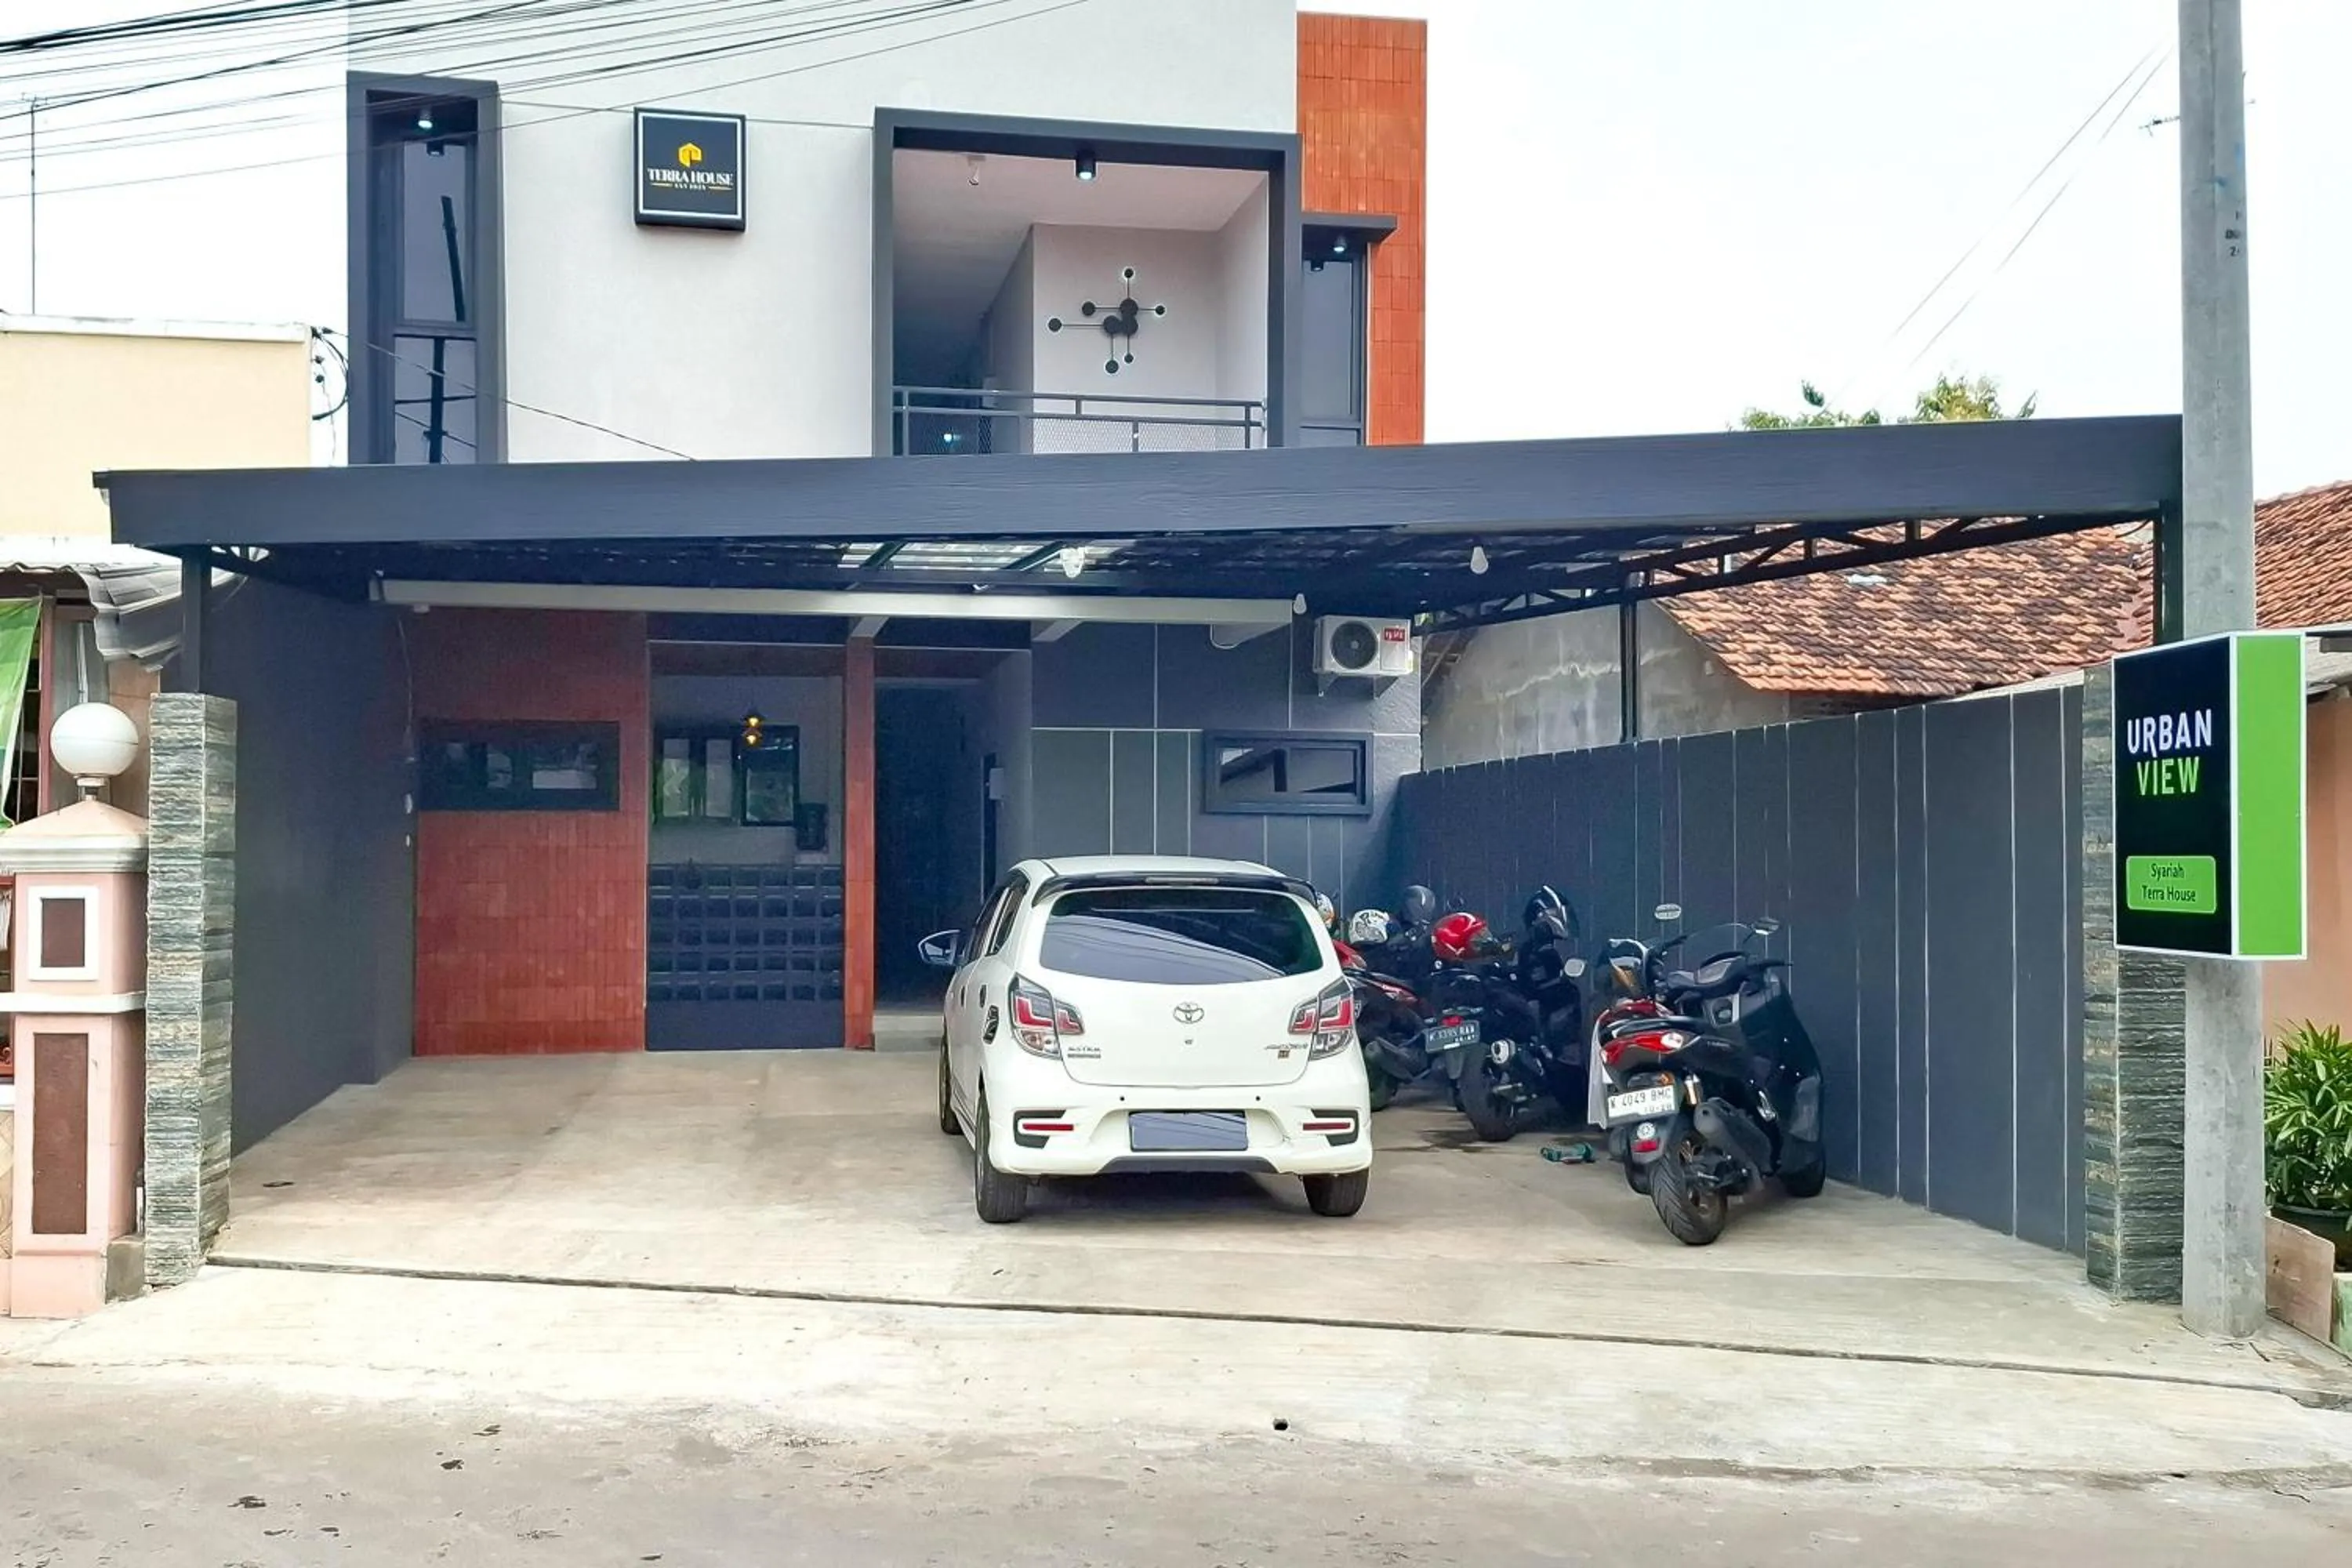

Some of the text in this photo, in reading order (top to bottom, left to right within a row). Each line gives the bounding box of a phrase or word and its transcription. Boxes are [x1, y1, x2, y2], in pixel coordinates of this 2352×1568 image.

[646, 167, 690, 183] TERRA
[691, 170, 734, 187] HOUSE
[2127, 709, 2212, 757] URBAN
[2136, 756, 2200, 796] VIEW
[2151, 862, 2184, 881] Syariah
[2141, 884, 2196, 902] Terra House
[1622, 1091, 1646, 1106] 4049
